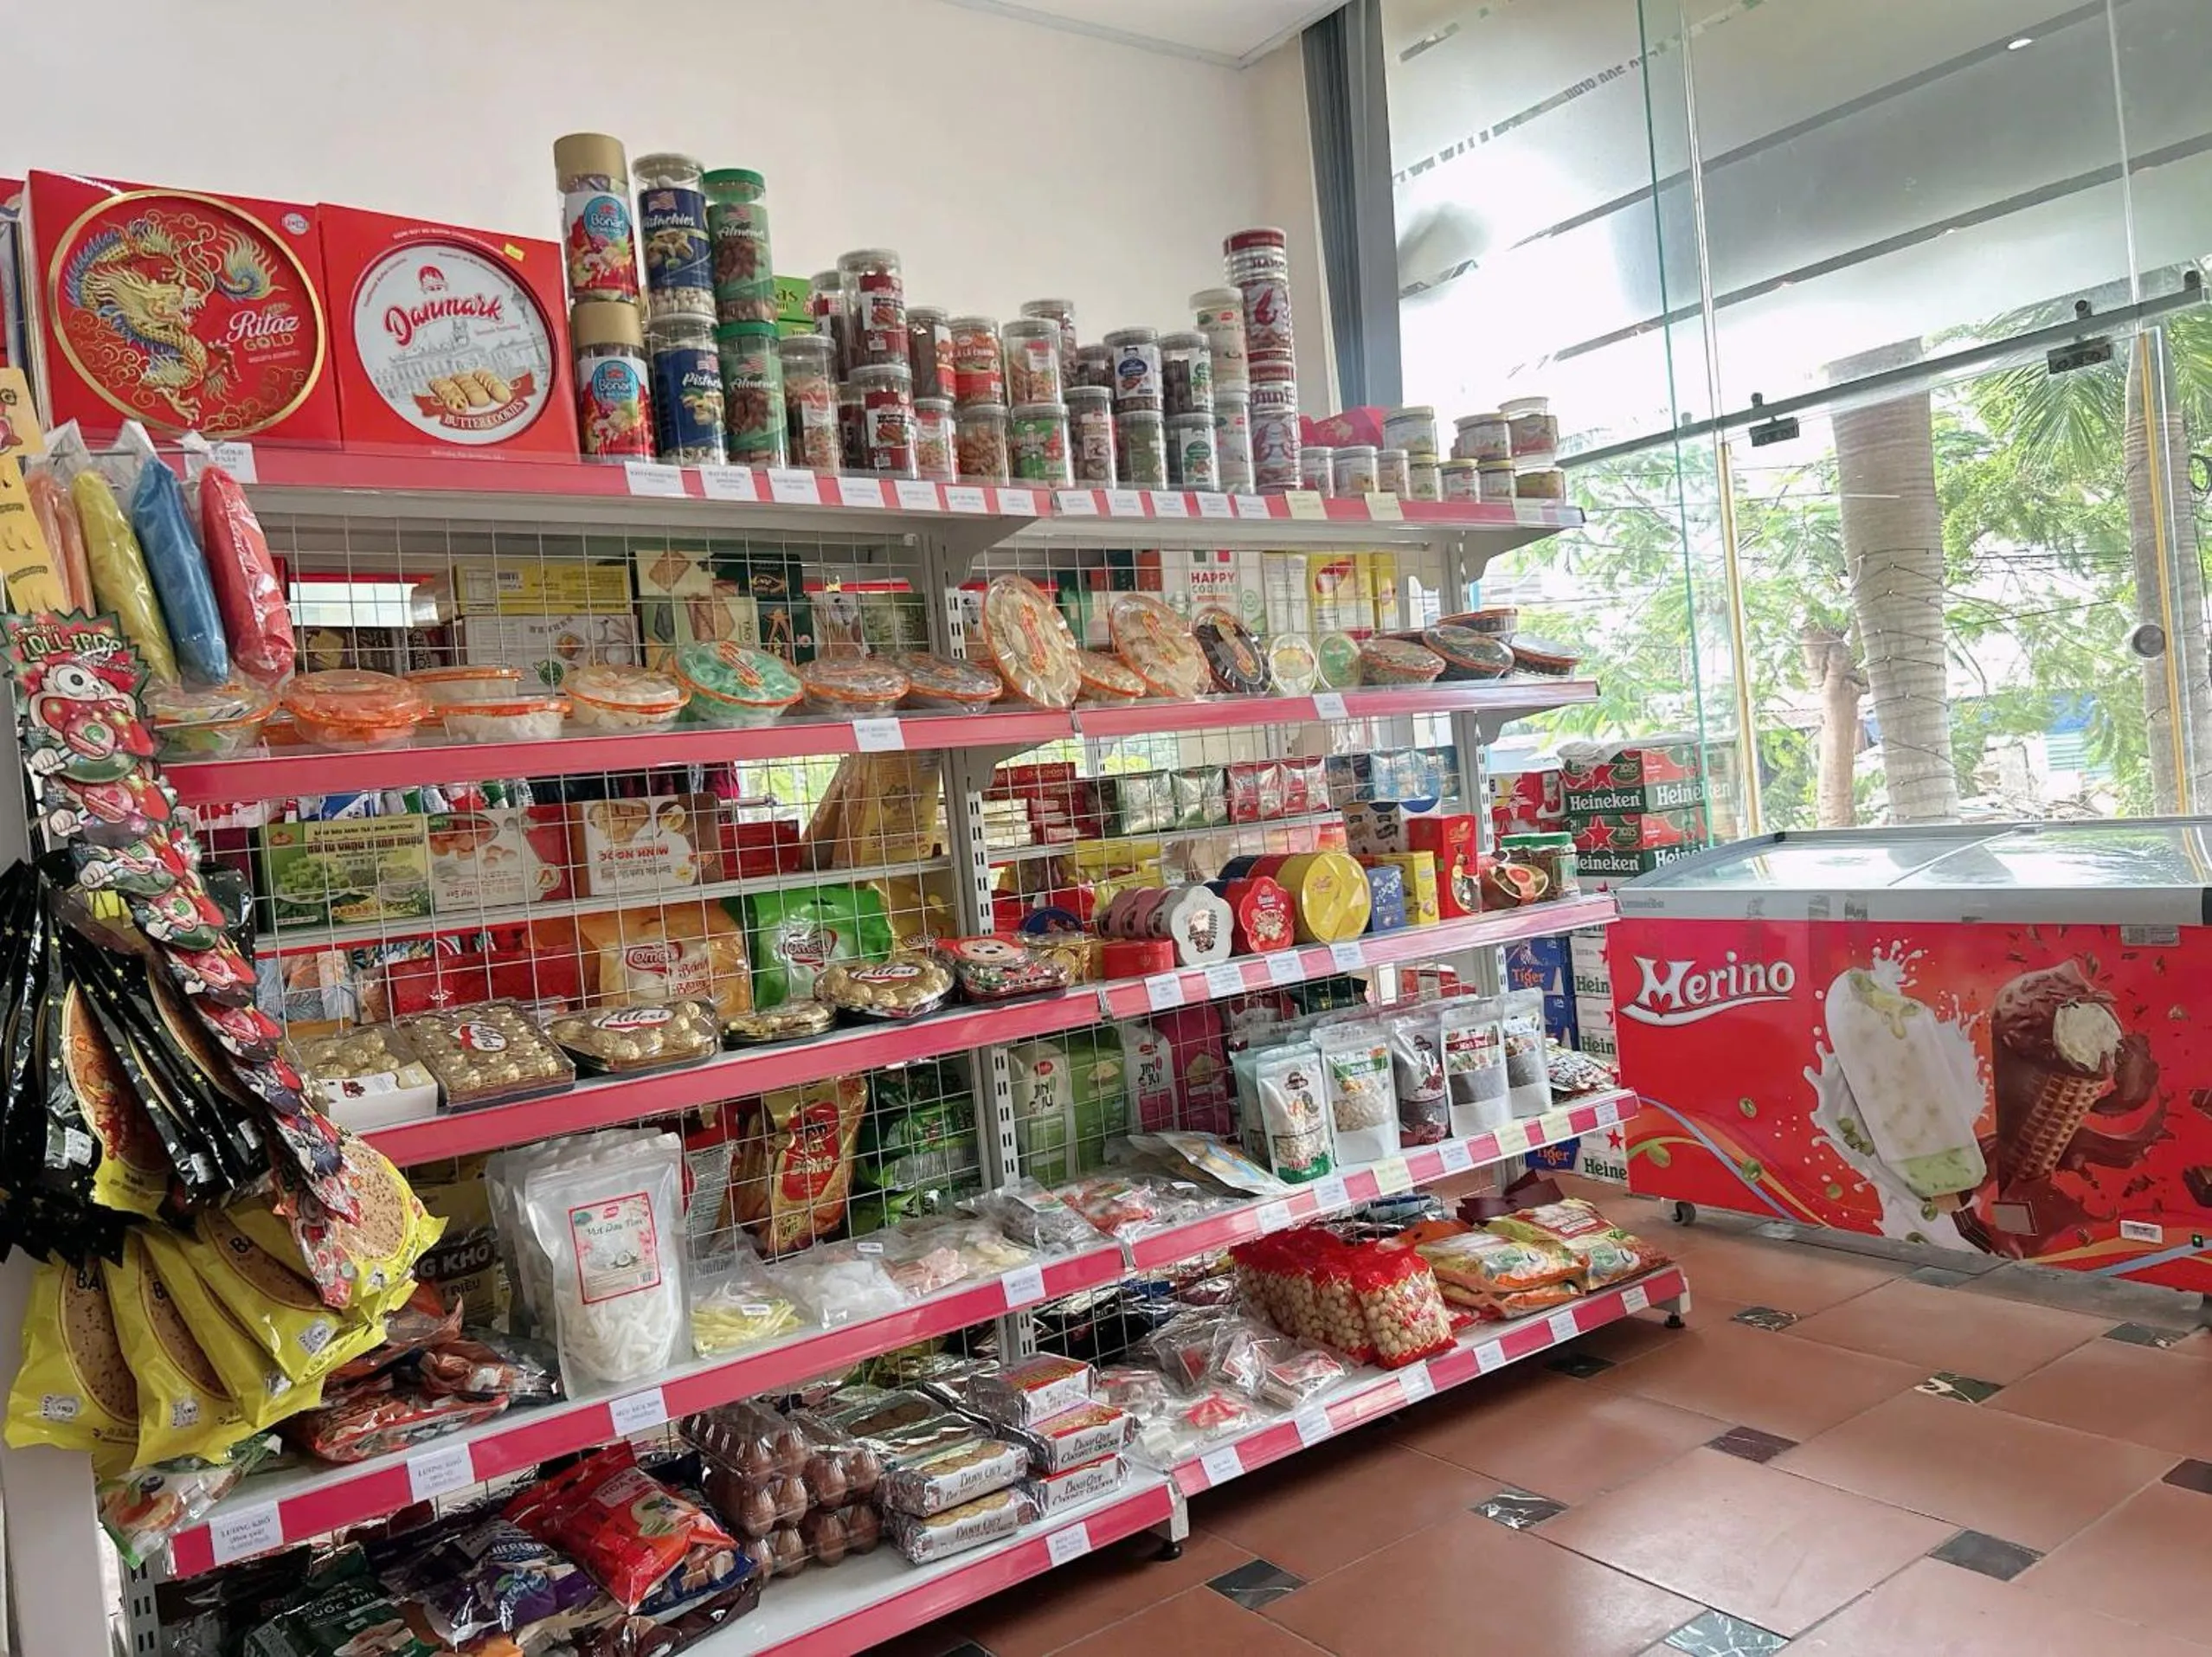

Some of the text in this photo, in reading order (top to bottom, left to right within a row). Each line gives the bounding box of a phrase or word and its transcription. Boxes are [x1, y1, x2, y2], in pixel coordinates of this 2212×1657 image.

[227, 311, 300, 343] Ritaz
[386, 294, 505, 346] Danmark
[243, 333, 294, 351] GOLD
[444, 401, 526, 429] BUTTER COOKIES
[1191, 572, 1235, 583] HAPPY
[21, 633, 123, 663] LOLLIPOP
[1570, 791, 1642, 812] Heineken
[1578, 855, 1640, 872] eineken
[1513, 967, 1610, 994] Tiger Hein
[1633, 951, 1796, 1010] Merino
[1581, 1036, 1616, 1056] Hein
[1583, 1157, 1628, 1180] Heine
